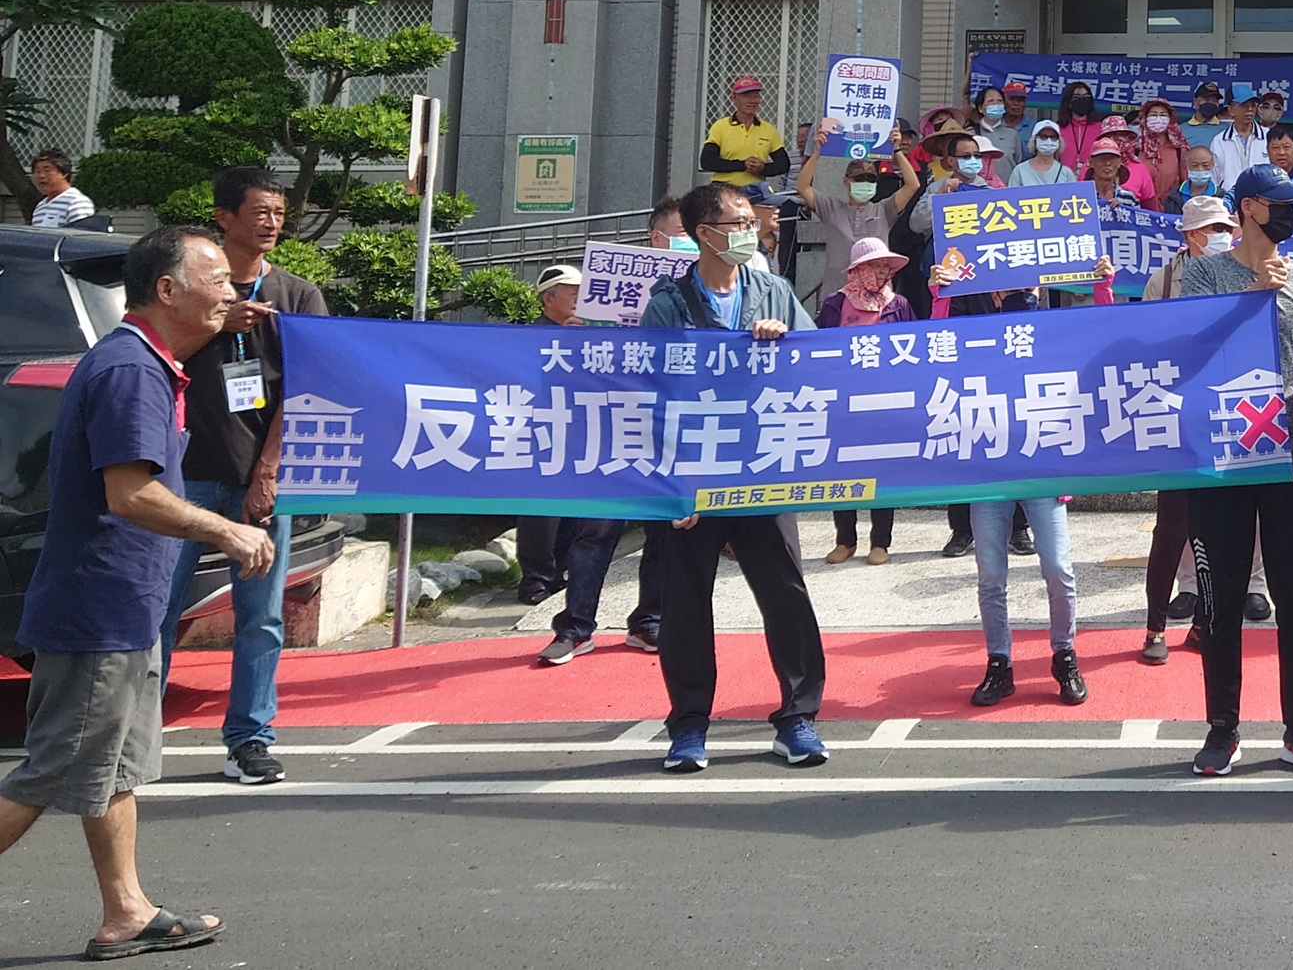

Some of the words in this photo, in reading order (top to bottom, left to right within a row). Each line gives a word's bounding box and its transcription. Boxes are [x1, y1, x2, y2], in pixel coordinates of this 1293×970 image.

[838, 63, 892, 81] 全鄉問題
[1057, 60, 1238, 77] 大城欺壓小村，一塔又建一塔
[841, 82, 886, 100] 不應由
[830, 101, 892, 120] 一村承擔
[942, 197, 1055, 238] 要公平
[976, 234, 1098, 270] 不要回饋
[583, 278, 643, 308] 見塔
[541, 324, 1036, 376] 大城欺壓小村，一塔又建一塔
[392, 360, 1184, 477] 反對頂庄第二納骨塔
[706, 482, 866, 508] 頂庄反二塔自救會
